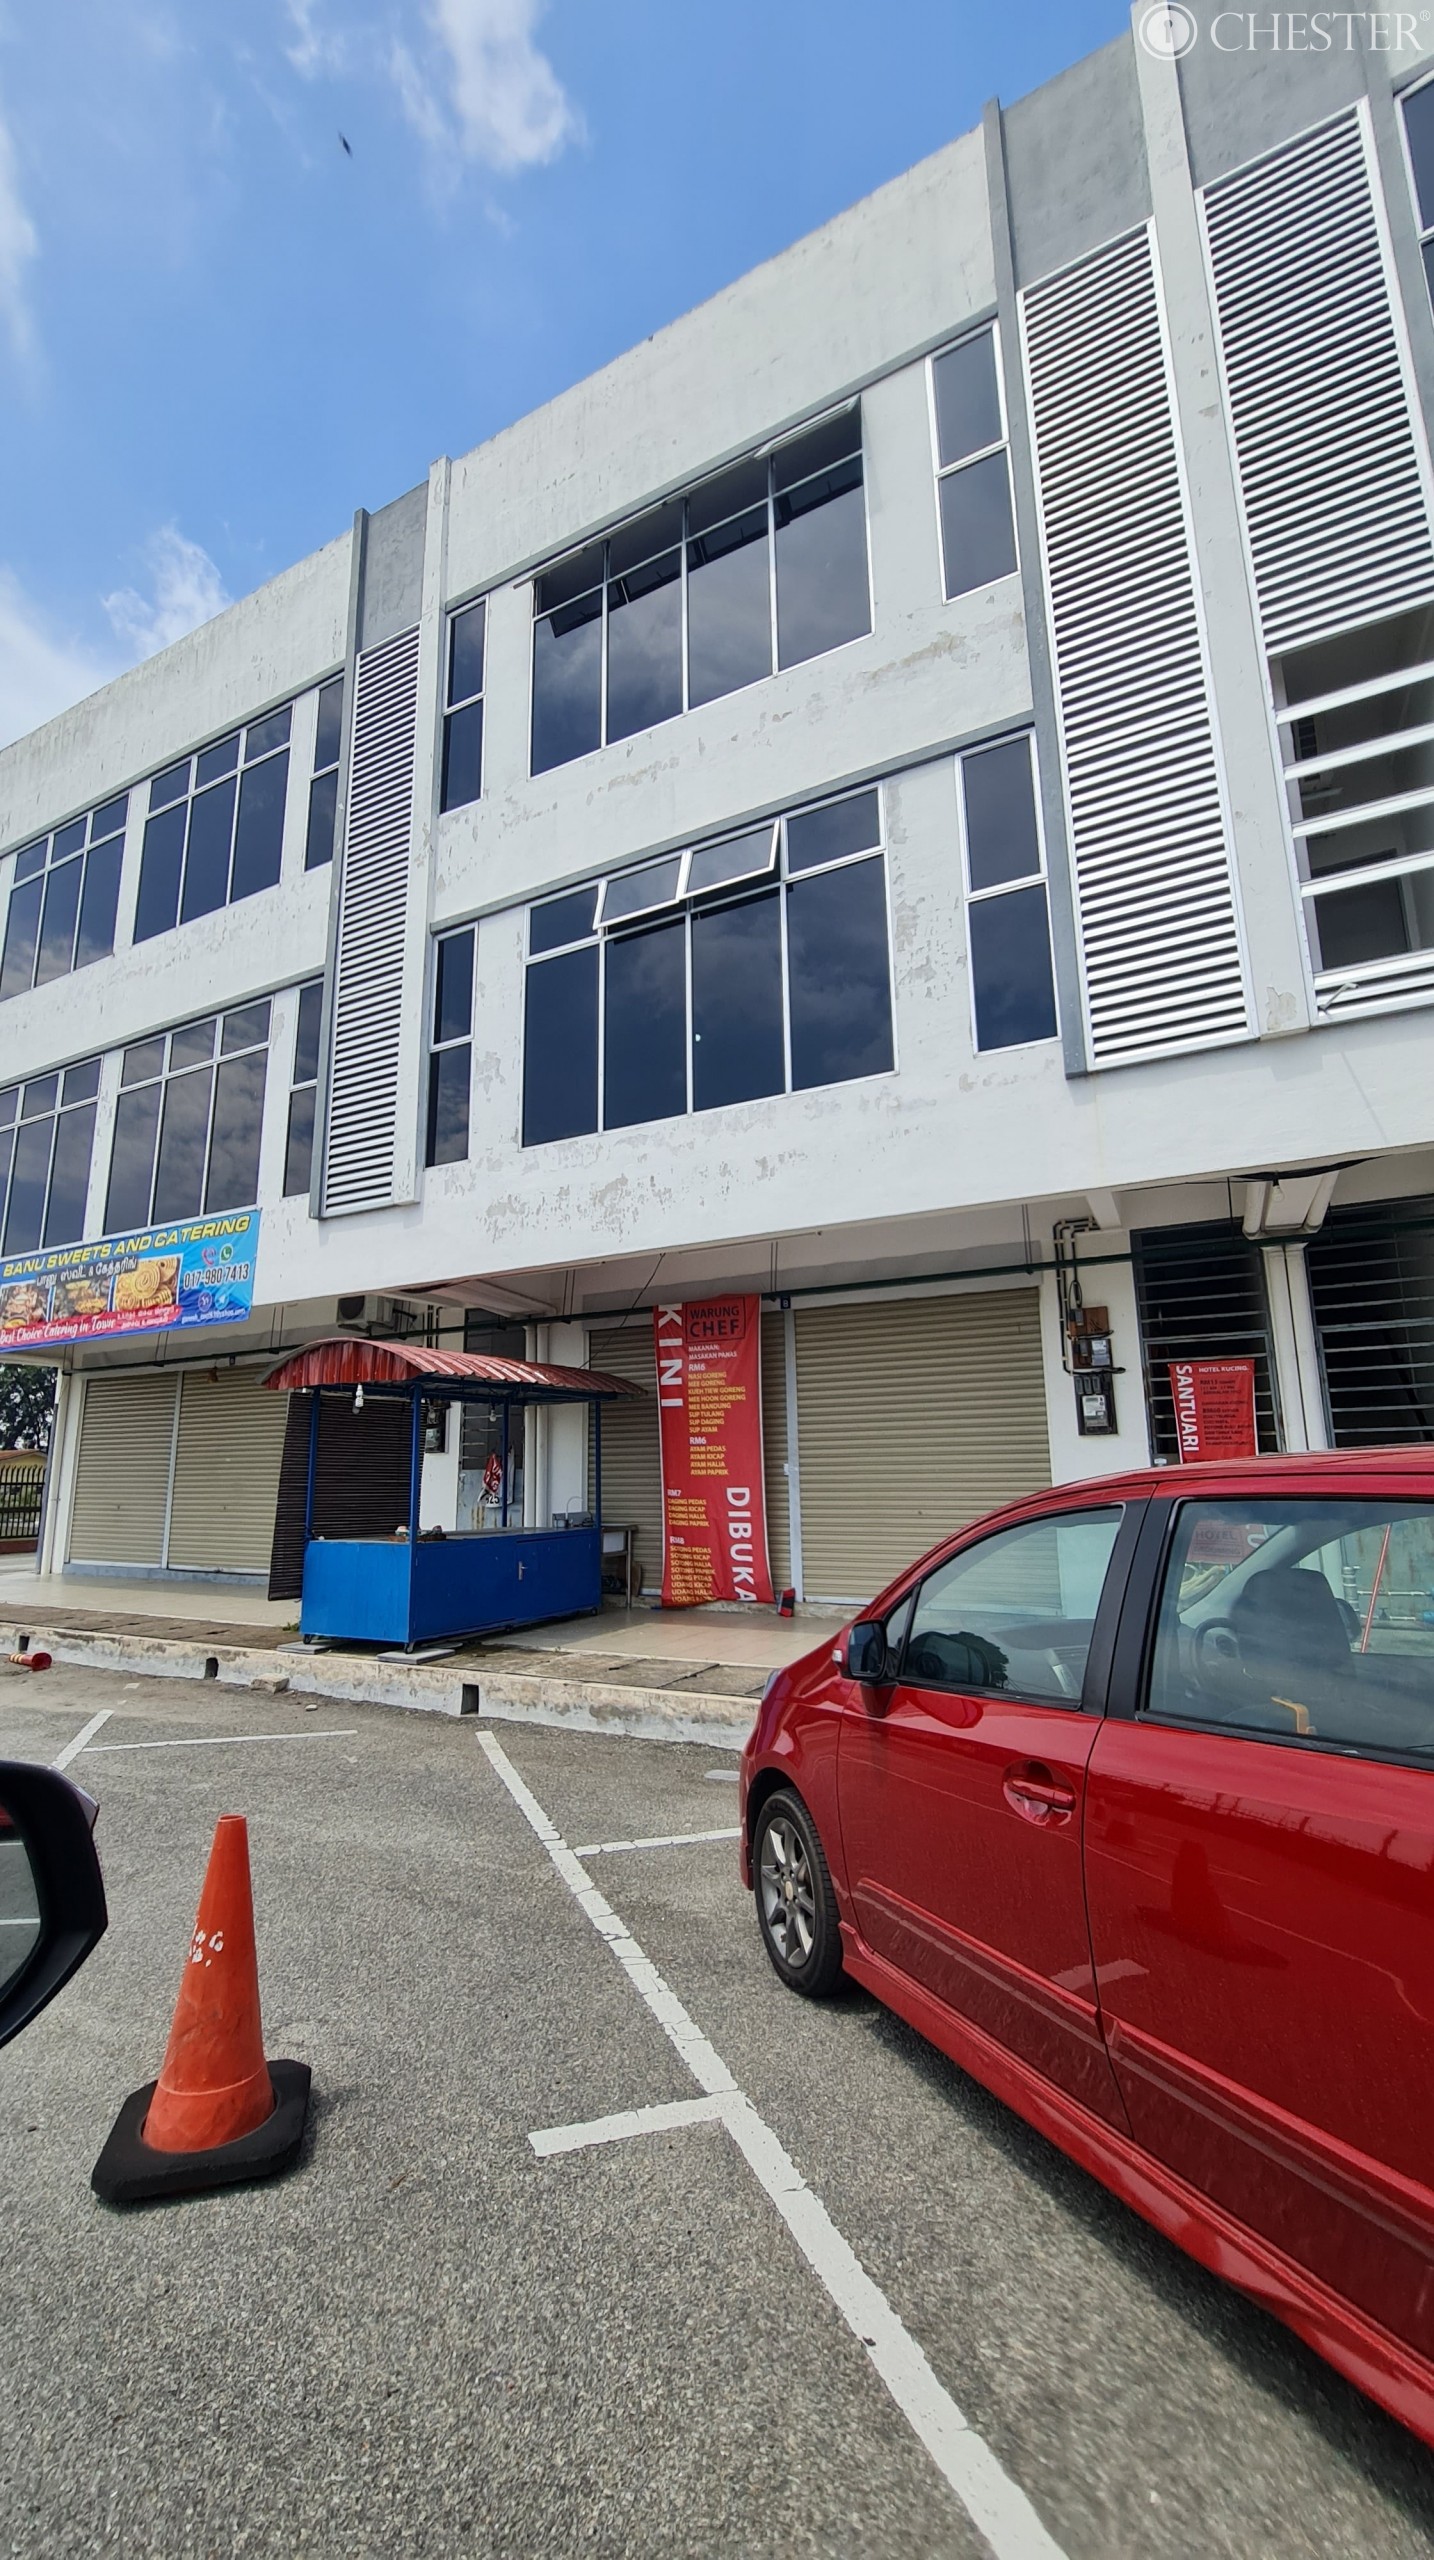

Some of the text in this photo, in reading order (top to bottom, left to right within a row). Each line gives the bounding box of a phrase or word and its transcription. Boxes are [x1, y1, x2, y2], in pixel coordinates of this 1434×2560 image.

[3, 1215, 251, 1277] BANU SWEETS AND CATERING
[184, 1263, 249, 1289] 017-980 7413
[690, 1305, 740, 1319] WARUNG
[690, 1319, 740, 1337] CHEF
[658, 1304, 683, 1407] KINI
[688, 1363, 706, 1371] RM6
[1176, 1365, 1199, 1451] SANTUARI
[689, 1437, 706, 1445] RM6
[726, 1487, 757, 1602] DIBUKA
